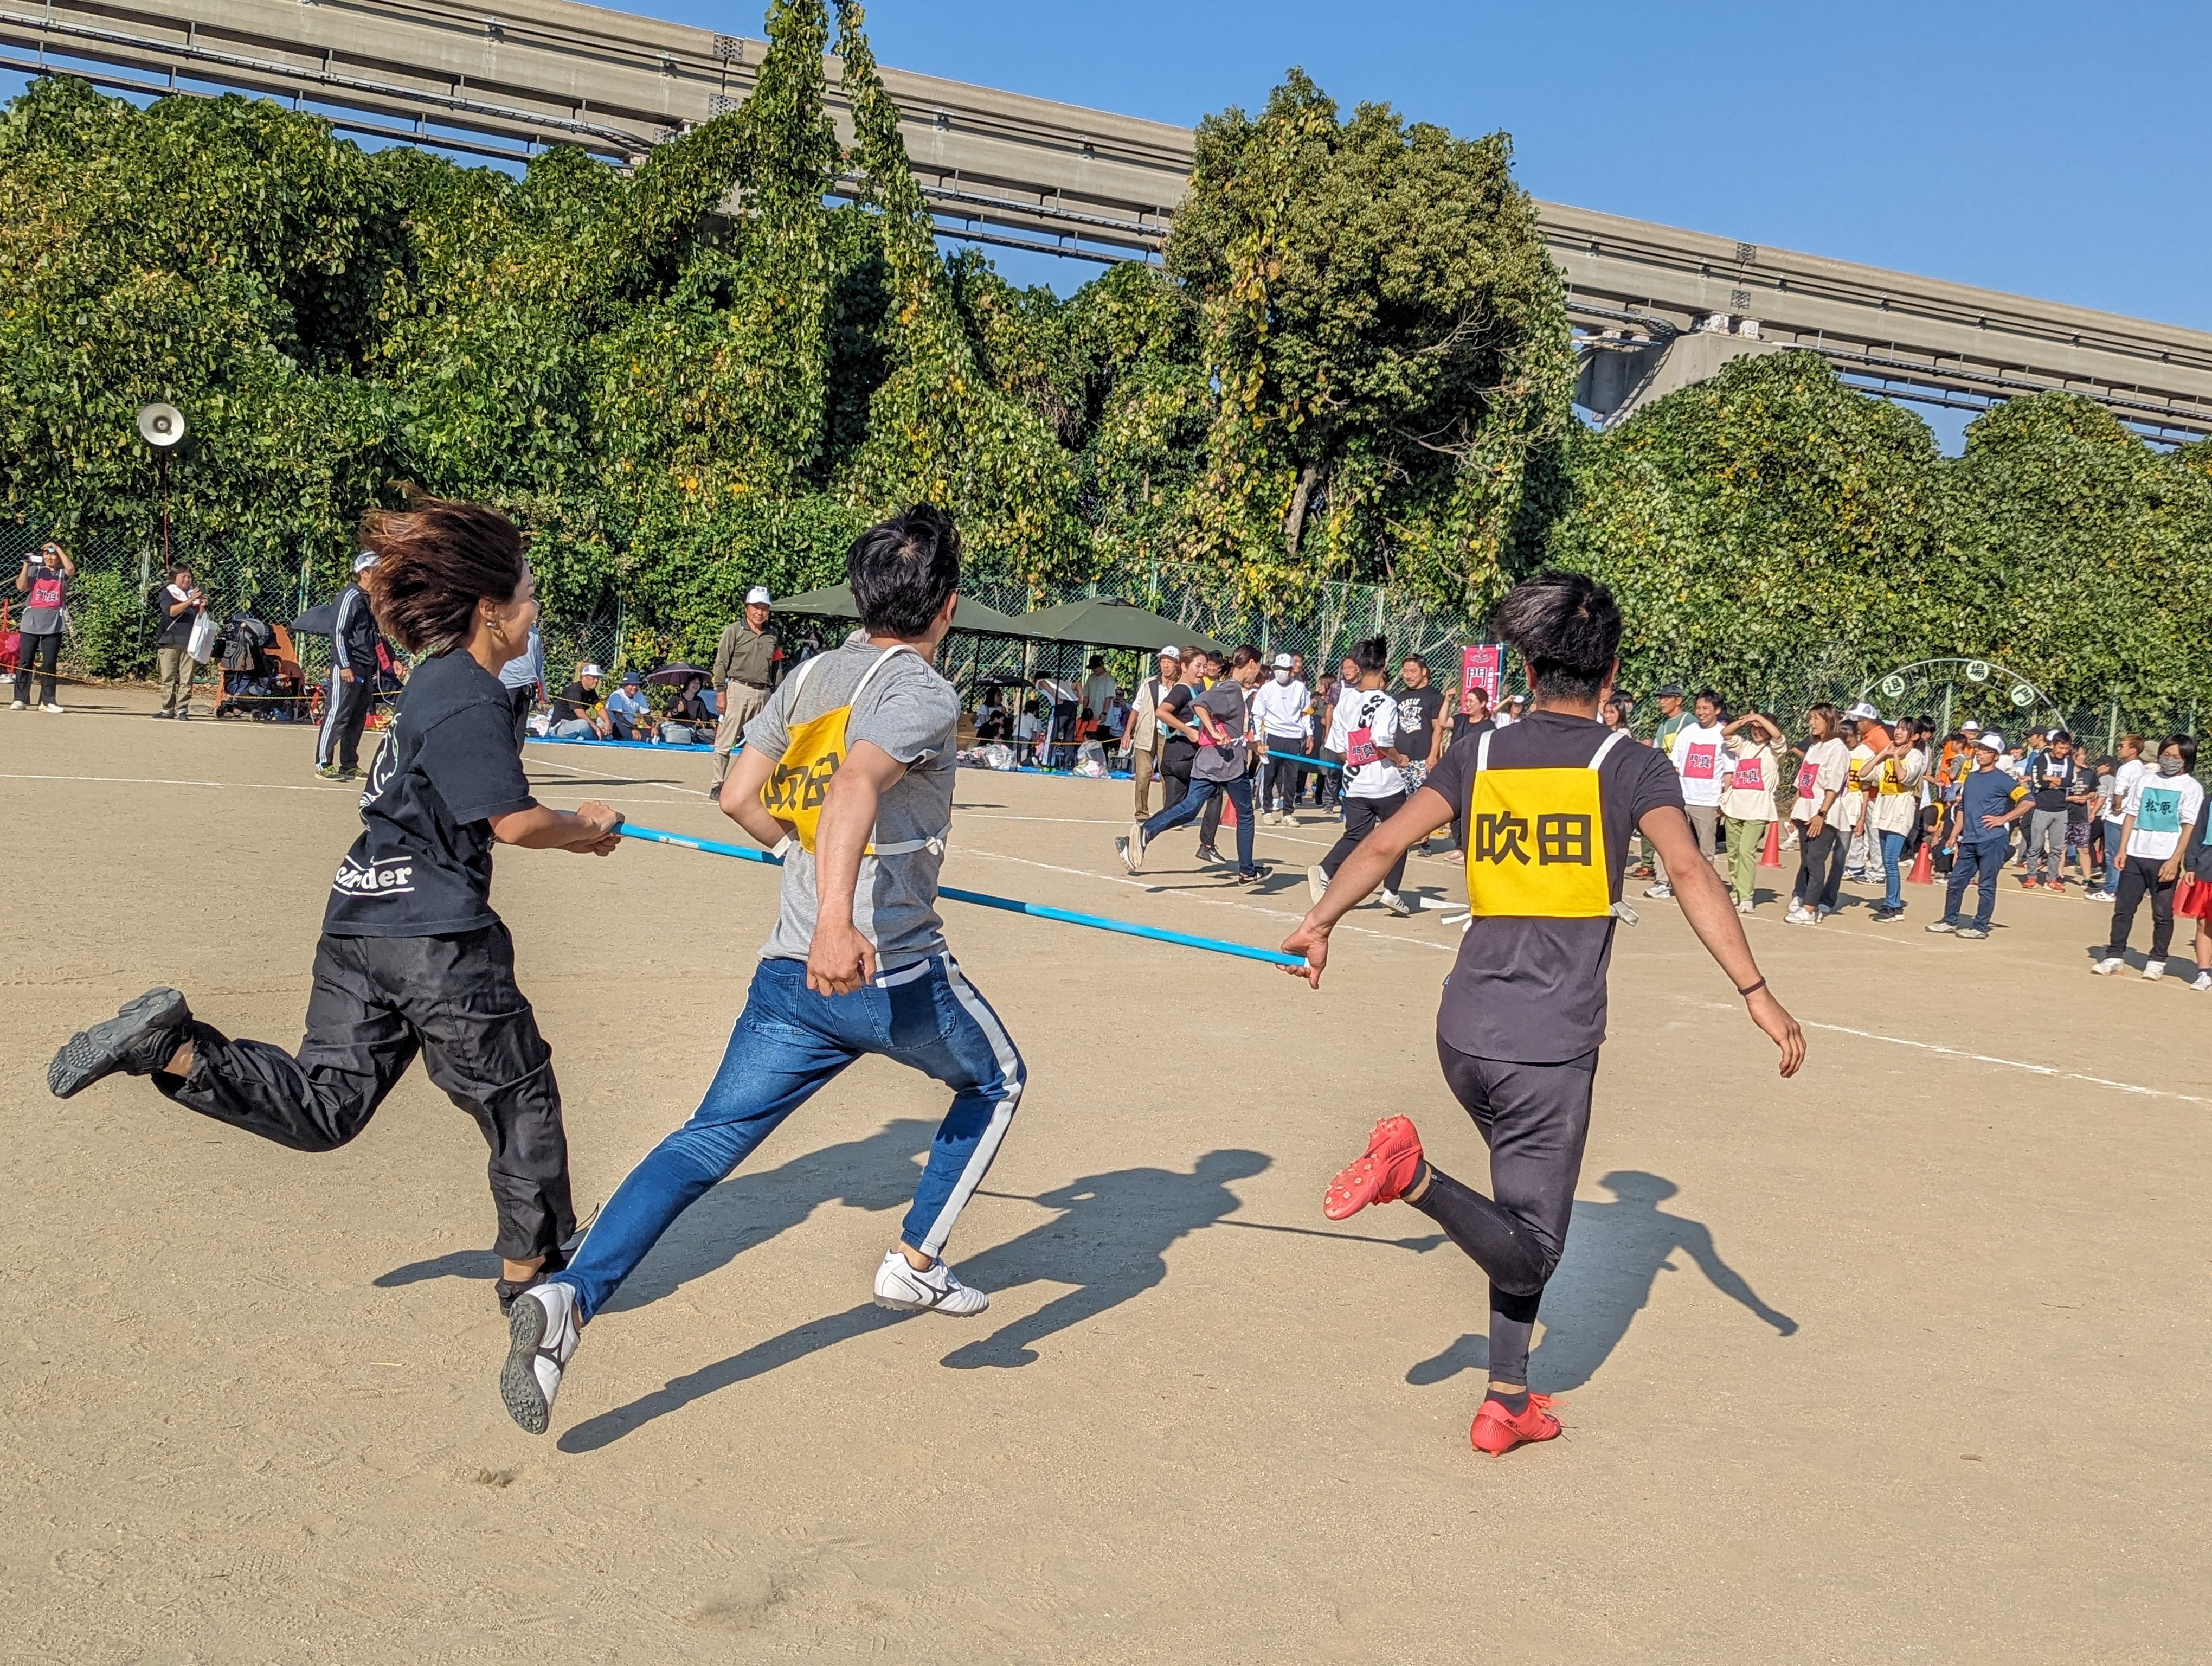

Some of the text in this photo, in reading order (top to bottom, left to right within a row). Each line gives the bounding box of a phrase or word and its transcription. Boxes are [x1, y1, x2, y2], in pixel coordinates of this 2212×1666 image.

[35, 589, 59, 603] 門真
[1465, 667, 1488, 694] 門
[1352, 743, 1378, 764] 門真
[1687, 753, 1713, 769] 門真
[1735, 768, 1760, 785] 門真
[2144, 798, 2172, 815] 松原
[1475, 810, 1592, 867] 吹田
